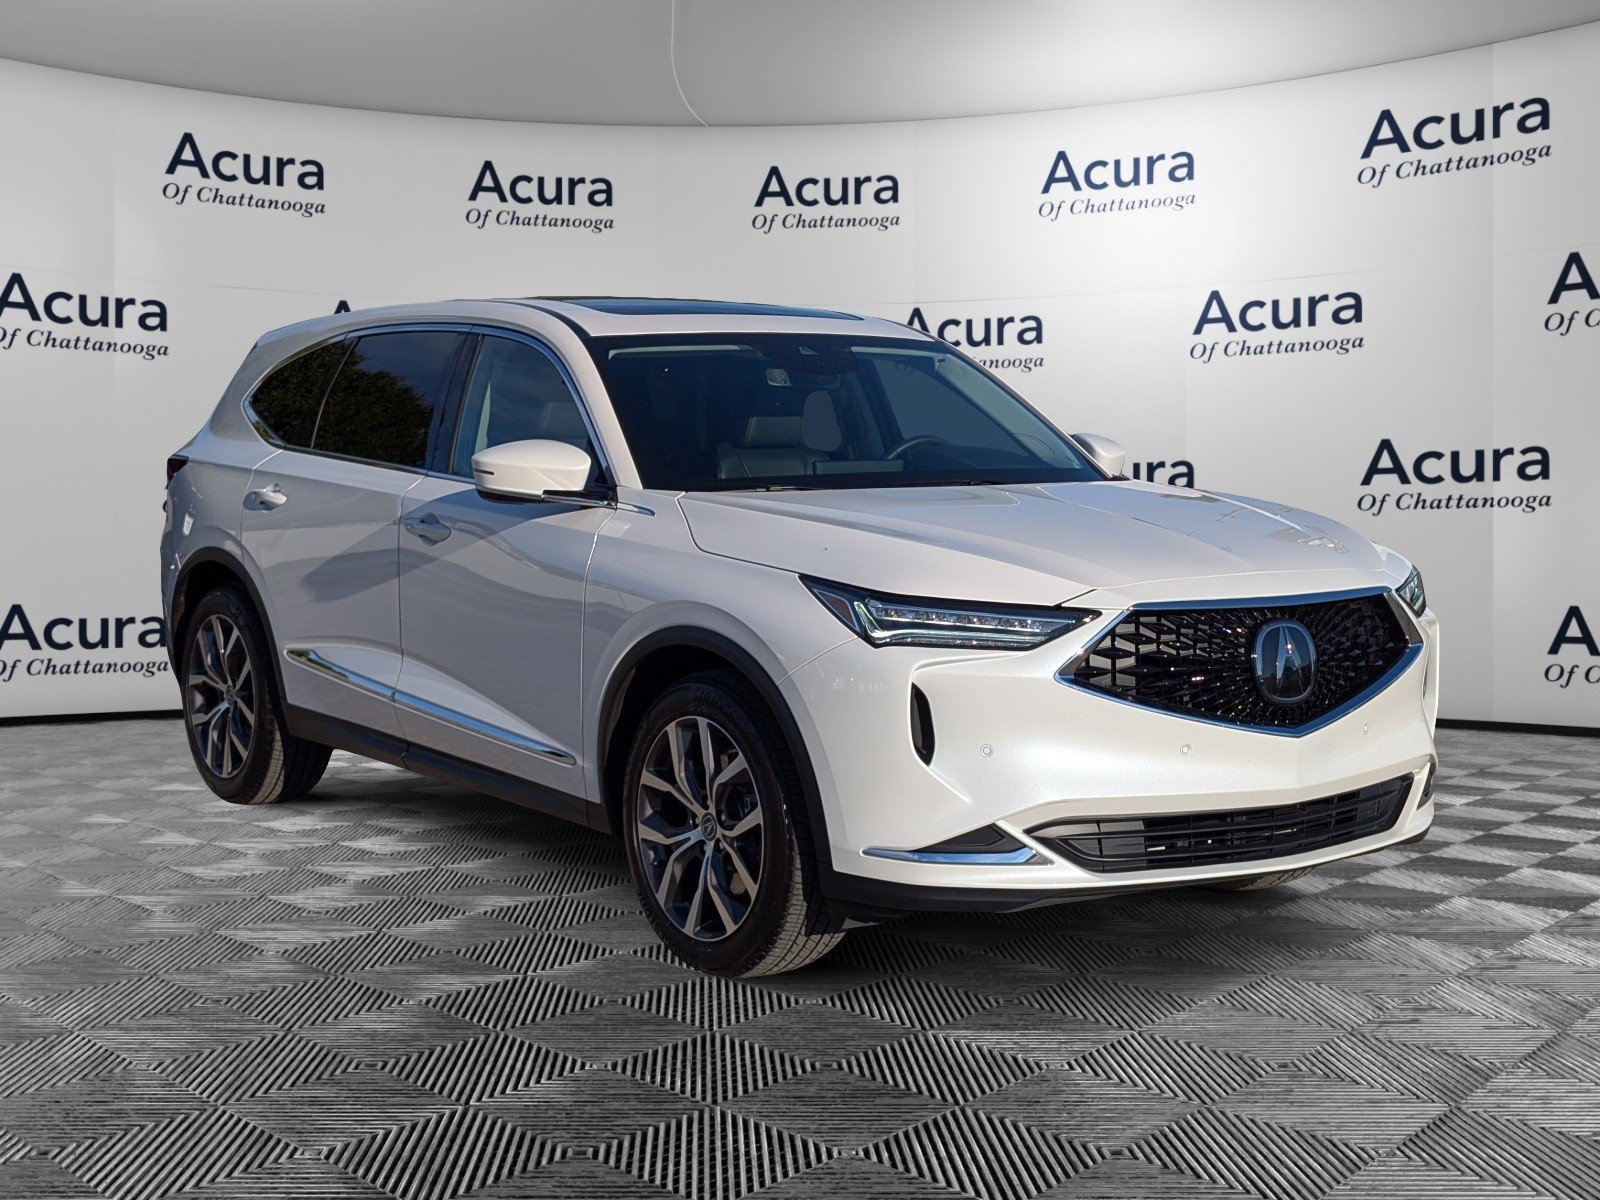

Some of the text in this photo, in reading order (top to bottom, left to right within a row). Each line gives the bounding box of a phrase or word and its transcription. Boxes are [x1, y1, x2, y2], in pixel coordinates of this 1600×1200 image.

[1360, 97, 1551, 159] Acura
[164, 131, 325, 192] Acura
[1041, 151, 1195, 194] Acura
[1357, 145, 1553, 188] Of Chattanooga
[161, 183, 326, 219] Of Chattanooga
[467, 160, 614, 208] Acura
[754, 166, 900, 208] Acura
[465, 208, 615, 234] Of Chattanooga
[752, 213, 900, 235] Of Chattanooga
[1038, 194, 1196, 221] Of Chattanooga
[0, 271, 169, 333] Acura
[1192, 290, 1363, 336] Acura
[1543, 310, 1580, 337] Of
[26, 329, 170, 361] Chattanooga
[1189, 337, 1365, 364] Of Chattanooga
[1360, 438, 1551, 487] Acura
[1357, 492, 1553, 517] Of Chattanooga
[0, 603, 167, 651] Acura
[26, 658, 169, 678] Chattanooga
[1543, 663, 1580, 689] Of
